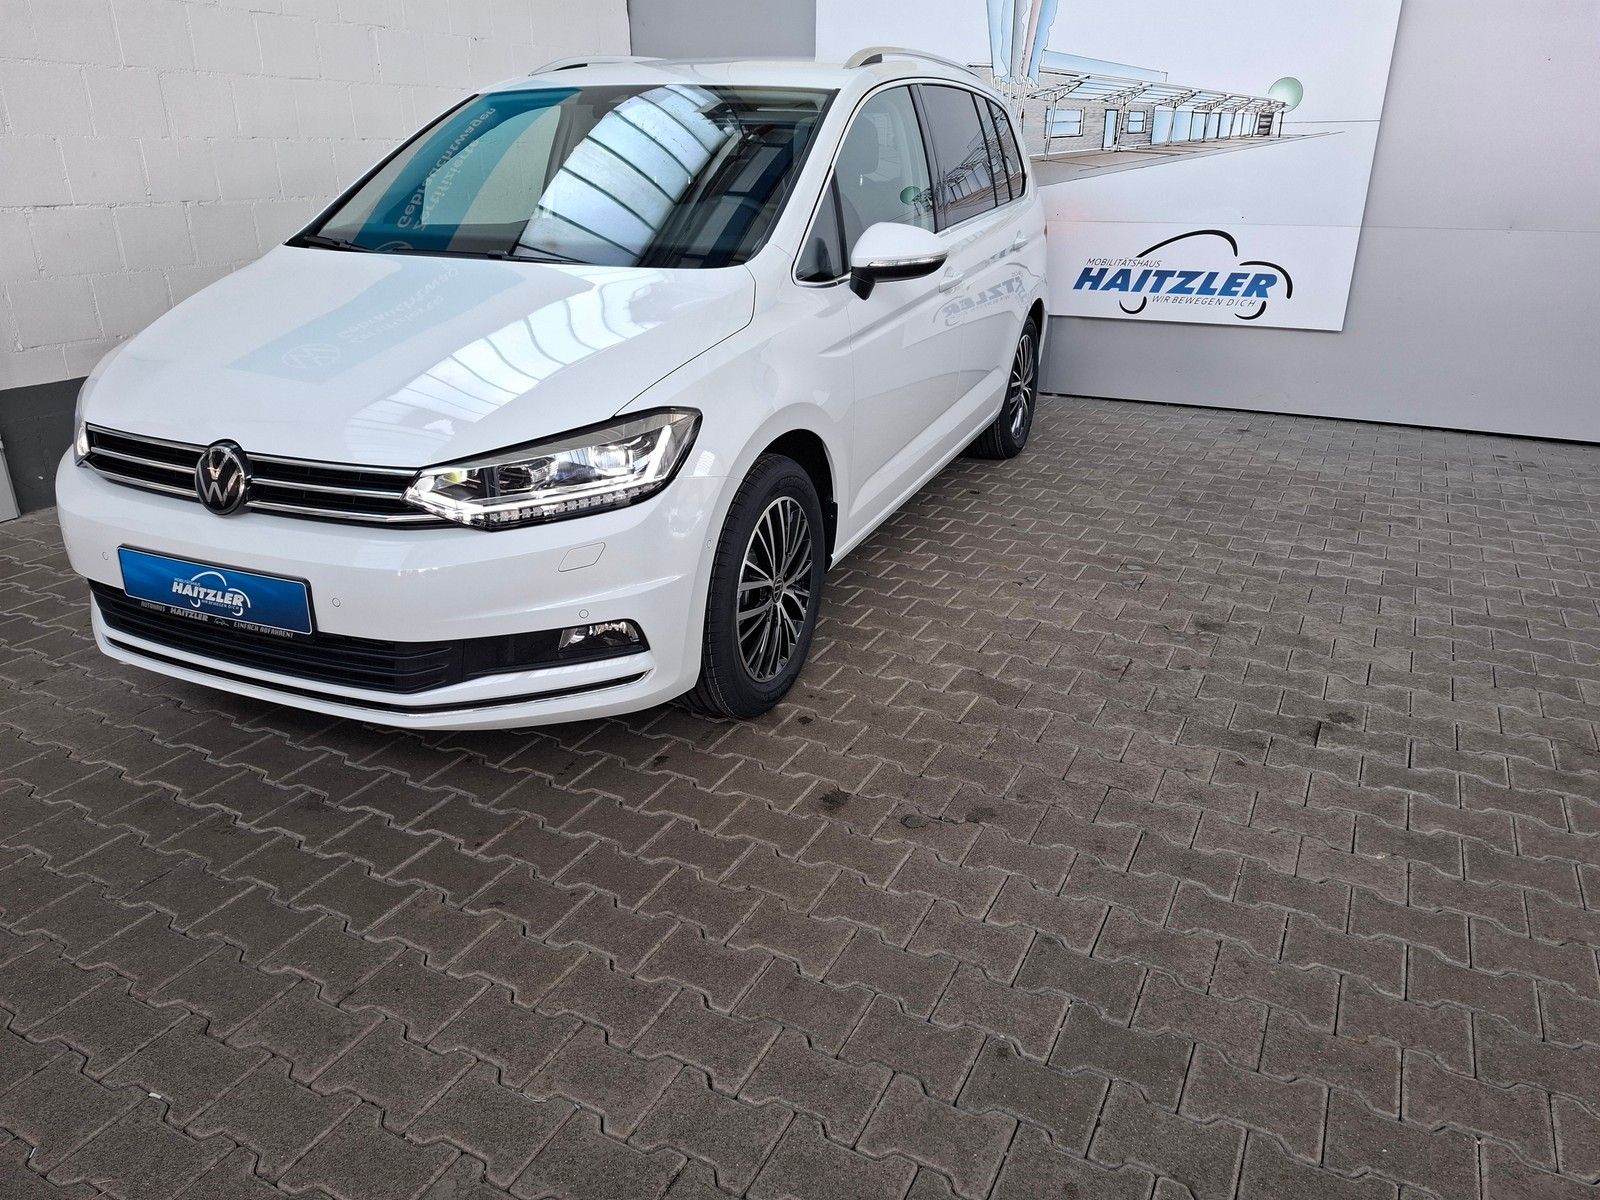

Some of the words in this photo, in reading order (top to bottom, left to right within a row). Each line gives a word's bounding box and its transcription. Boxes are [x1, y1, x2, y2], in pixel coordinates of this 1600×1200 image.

[1086, 256, 1162, 268] MOBILITÄTSHAUS
[1073, 267, 1278, 298] HAITZLER
[1152, 295, 1170, 303] WIR
[1171, 297, 1223, 306] BEWEGEN
[1226, 299, 1256, 307] DICH
[172, 581, 244, 607] HAITZLER
[170, 607, 209, 622] HAITZLER
[233, 621, 259, 632] EINFACH
